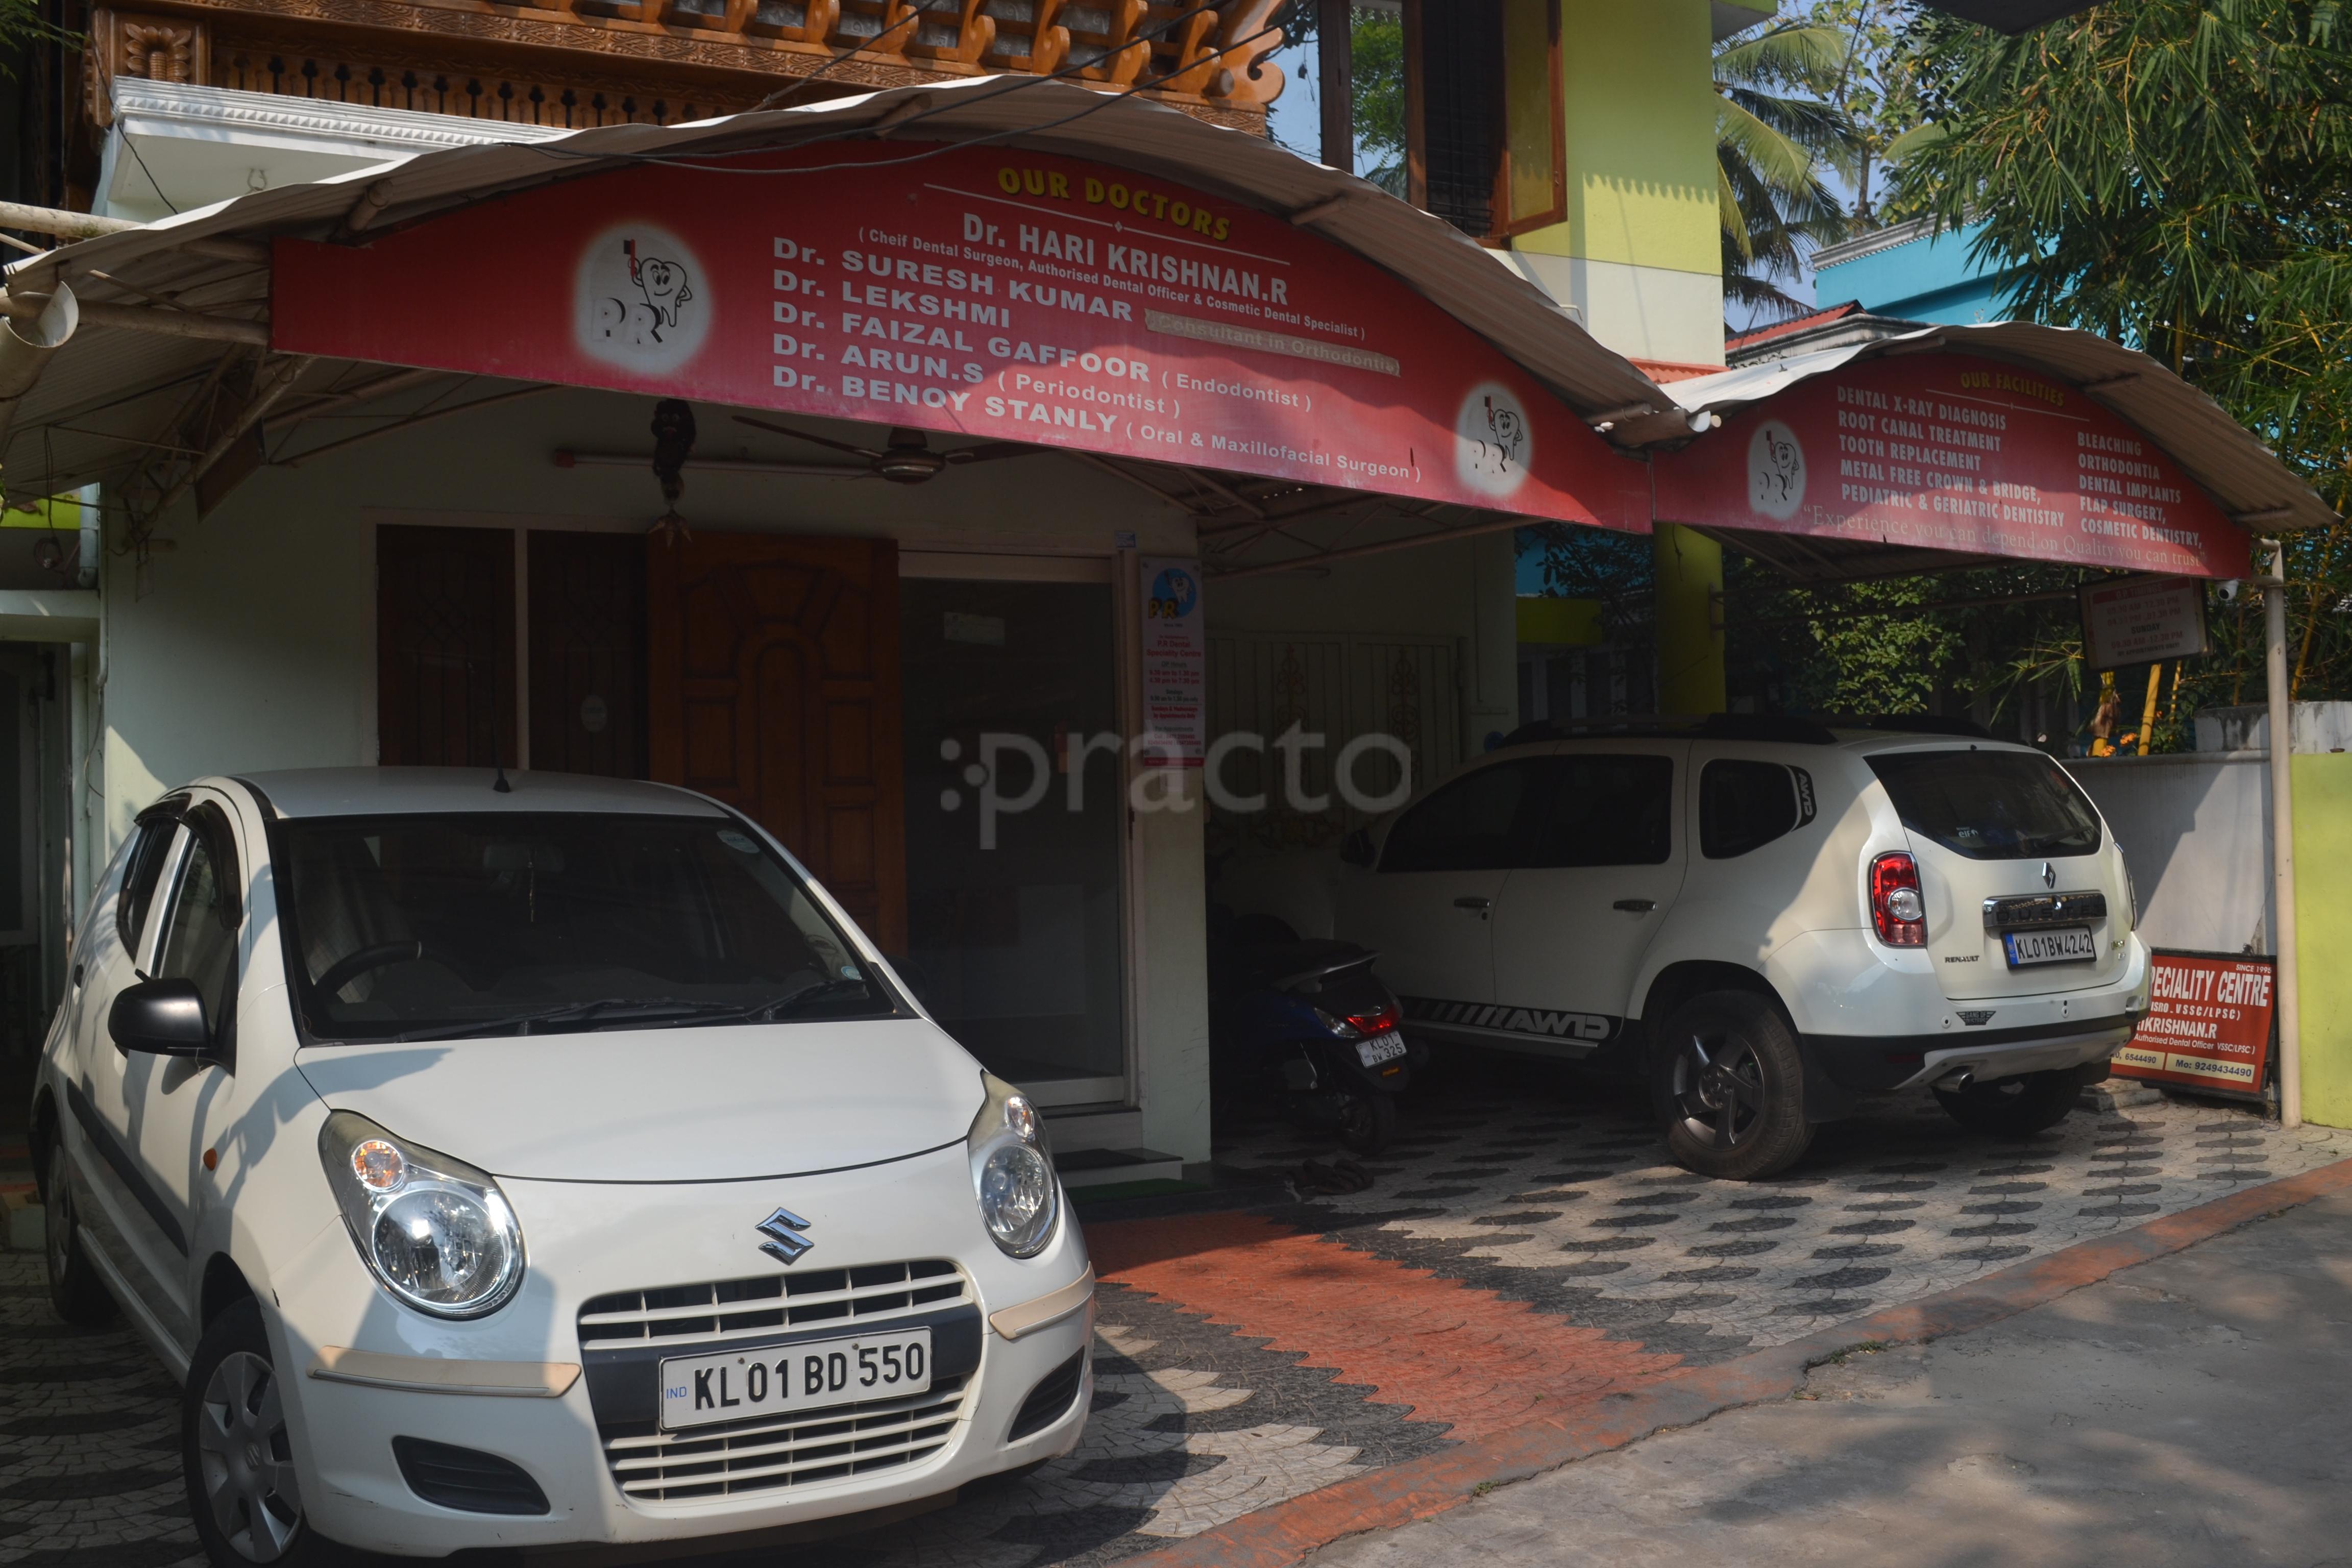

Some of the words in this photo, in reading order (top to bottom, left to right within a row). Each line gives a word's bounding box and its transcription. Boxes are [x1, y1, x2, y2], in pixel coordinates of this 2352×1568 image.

[998, 167, 1070, 199] OUR
[1086, 177, 1231, 242] DOCTORS
[964, 213, 1004, 247] Dr.
[1020, 224, 1094, 265] HARI
[1109, 243, 1287, 308] KRISHNAN.R
[774, 237, 824, 265] Dr.
[842, 247, 994, 295] SURESH
[1010, 280, 1132, 324] KUMAR
[870, 229, 907, 247] Cheif
[912, 235, 960, 258] Dental
[964, 247, 1023, 272] Surgeon,
[1028, 260, 1098, 284] Authorised
[1104, 275, 1143, 293] Dental
[1148, 284, 1189, 302] Officer
[1193, 292, 1202, 305] &
[1207, 296, 1260, 316] Cosmetic
[1265, 307, 1300, 324] Dental
[1305, 315, 1357, 336] Specialist
[774, 270, 824, 297] Dr.
[843, 281, 1009, 333] LEKSHMI
[774, 301, 824, 328] Dr.
[843, 313, 973, 352] FAIZAL
[988, 337, 1153, 384] GAFFOOR
[1177, 374, 1298, 406] Endodontist
[774, 333, 824, 360] Dr.
[841, 345, 983, 383] ARUN.S
[1017, 371, 1167, 413] Periodontist
[1961, 372, 1990, 389] OUR
[1996, 373, 2065, 407] FACILITIES
[774, 365, 825, 394] Dr.
[843, 374, 971, 411] BENOY
[985, 397, 1117, 432] STANLY
[1141, 425, 1182, 444] Oral
[1190, 432, 1204, 448] &
[1212, 435, 1329, 465] Maxillofacial
[1337, 455, 1409, 478] Surgeon
[1837, 386, 1888, 409] DENTAL
[1894, 396, 1932, 417] X-RAY
[1940, 404, 2005, 430] DIAGNOSIS
[1839, 410, 1875, 431] ROOT
[1881, 418, 1923, 439] CANAL
[1929, 425, 2000, 451] TREATMENT
[2078, 432, 2141, 456] BLEACHING
[1839, 434, 1884, 457] TOOTH
[1891, 443, 1980, 471] REPLACEMENT
[2078, 453, 2160, 479] ORTHODONTIA
[1841, 459, 1884, 480] METAL
[1890, 466, 1920, 485] FREE
[1927, 472, 1973, 493] CROWN
[1978, 479, 1988, 495] &
[1993, 482, 2041, 505] BRIDGE,
[2079, 475, 2122, 494] DENTAL
[2127, 482, 2180, 503] IMPLANTS
[1842, 483, 1912, 508] PEDIATRIC
[1919, 494, 1927, 510] &
[1934, 496, 1998, 519] GERIATRIC
[2003, 504, 2064, 527] DENTISTRY
[2079, 496, 2108, 513] FLAP
[2113, 501, 2165, 524] SURGERY,
[1915, 524, 1940, 542] you
[1949, 525, 1976, 542] can
[1982, 526, 2036, 549] depend
[2041, 537, 2059, 552] on
[2064, 534, 2114, 559] Quality
[2119, 546, 2141, 561] you
[2146, 547, 2167, 563] can
[2081, 518, 2137, 538] COSMETIC
[2142, 525, 2201, 549] DENTISTRY,
[1148, 598, 1179, 619] PR
[2131, 624, 2160, 634] SUNDAY
[1147, 649, 1178, 657] Speciality
[2236, 964, 2254, 972] SINCE
[2217, 971, 2271, 1007] CENTRE
[1384, 1043, 1403, 1058] 325
[2125, 1052, 2156, 1064] 6544490
[2169, 1038, 2190, 1047] Dental
[2192, 1041, 2214, 1050] Officer
[2175, 1059, 2191, 1069] Mo:
[2195, 1062, 2251, 1077] 9249434490
[666, 1386, 687, 1399] IND
[858, 1342, 924, 1387] 550
